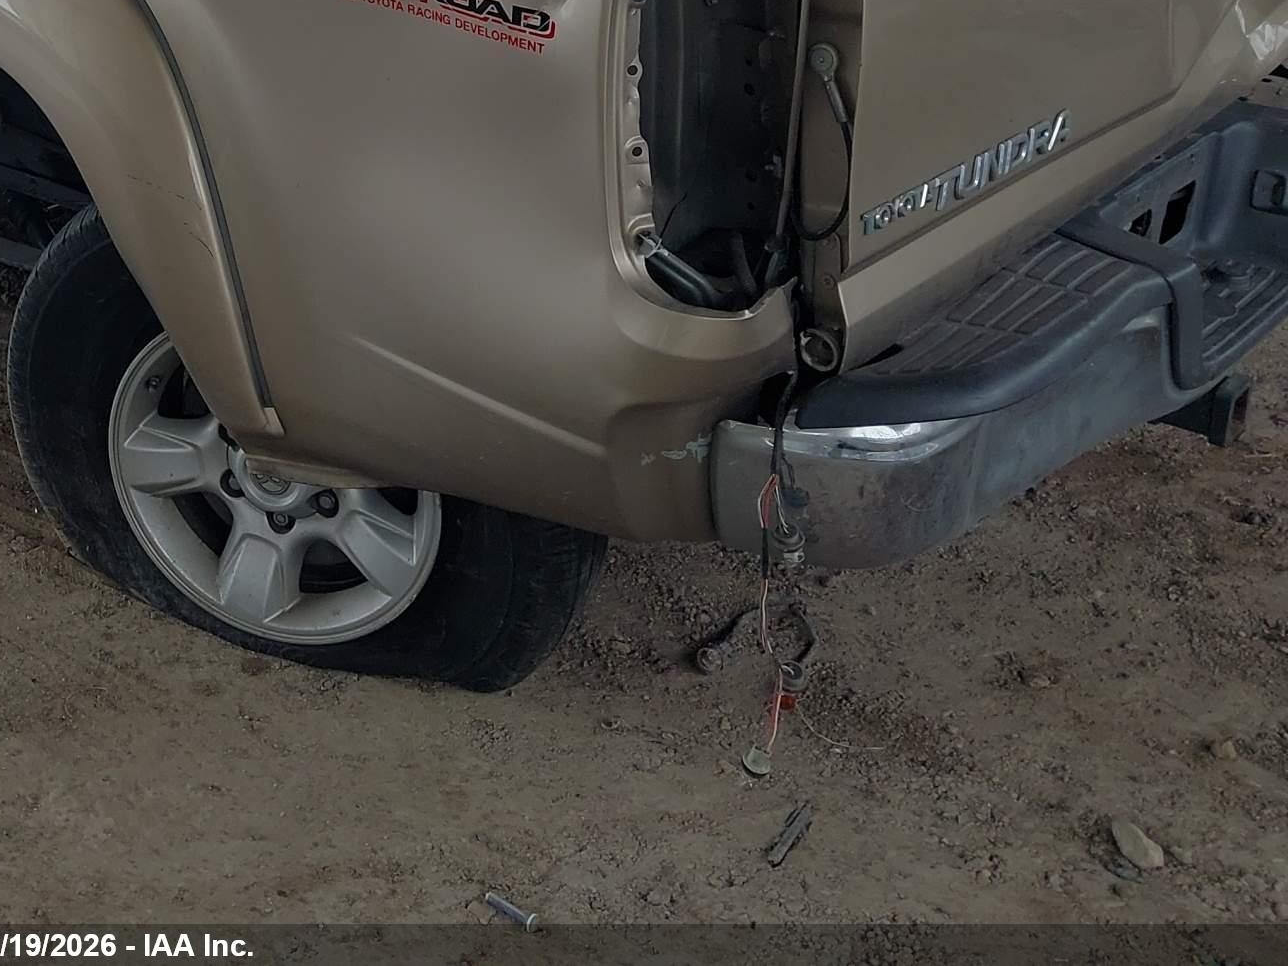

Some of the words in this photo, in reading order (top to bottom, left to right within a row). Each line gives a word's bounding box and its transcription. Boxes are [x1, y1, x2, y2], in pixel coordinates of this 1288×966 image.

[407, 4, 451, 26] RACING
[454, 17, 546, 55] DEVELOPMENT
[931, 109, 1070, 211] TUNDRA
